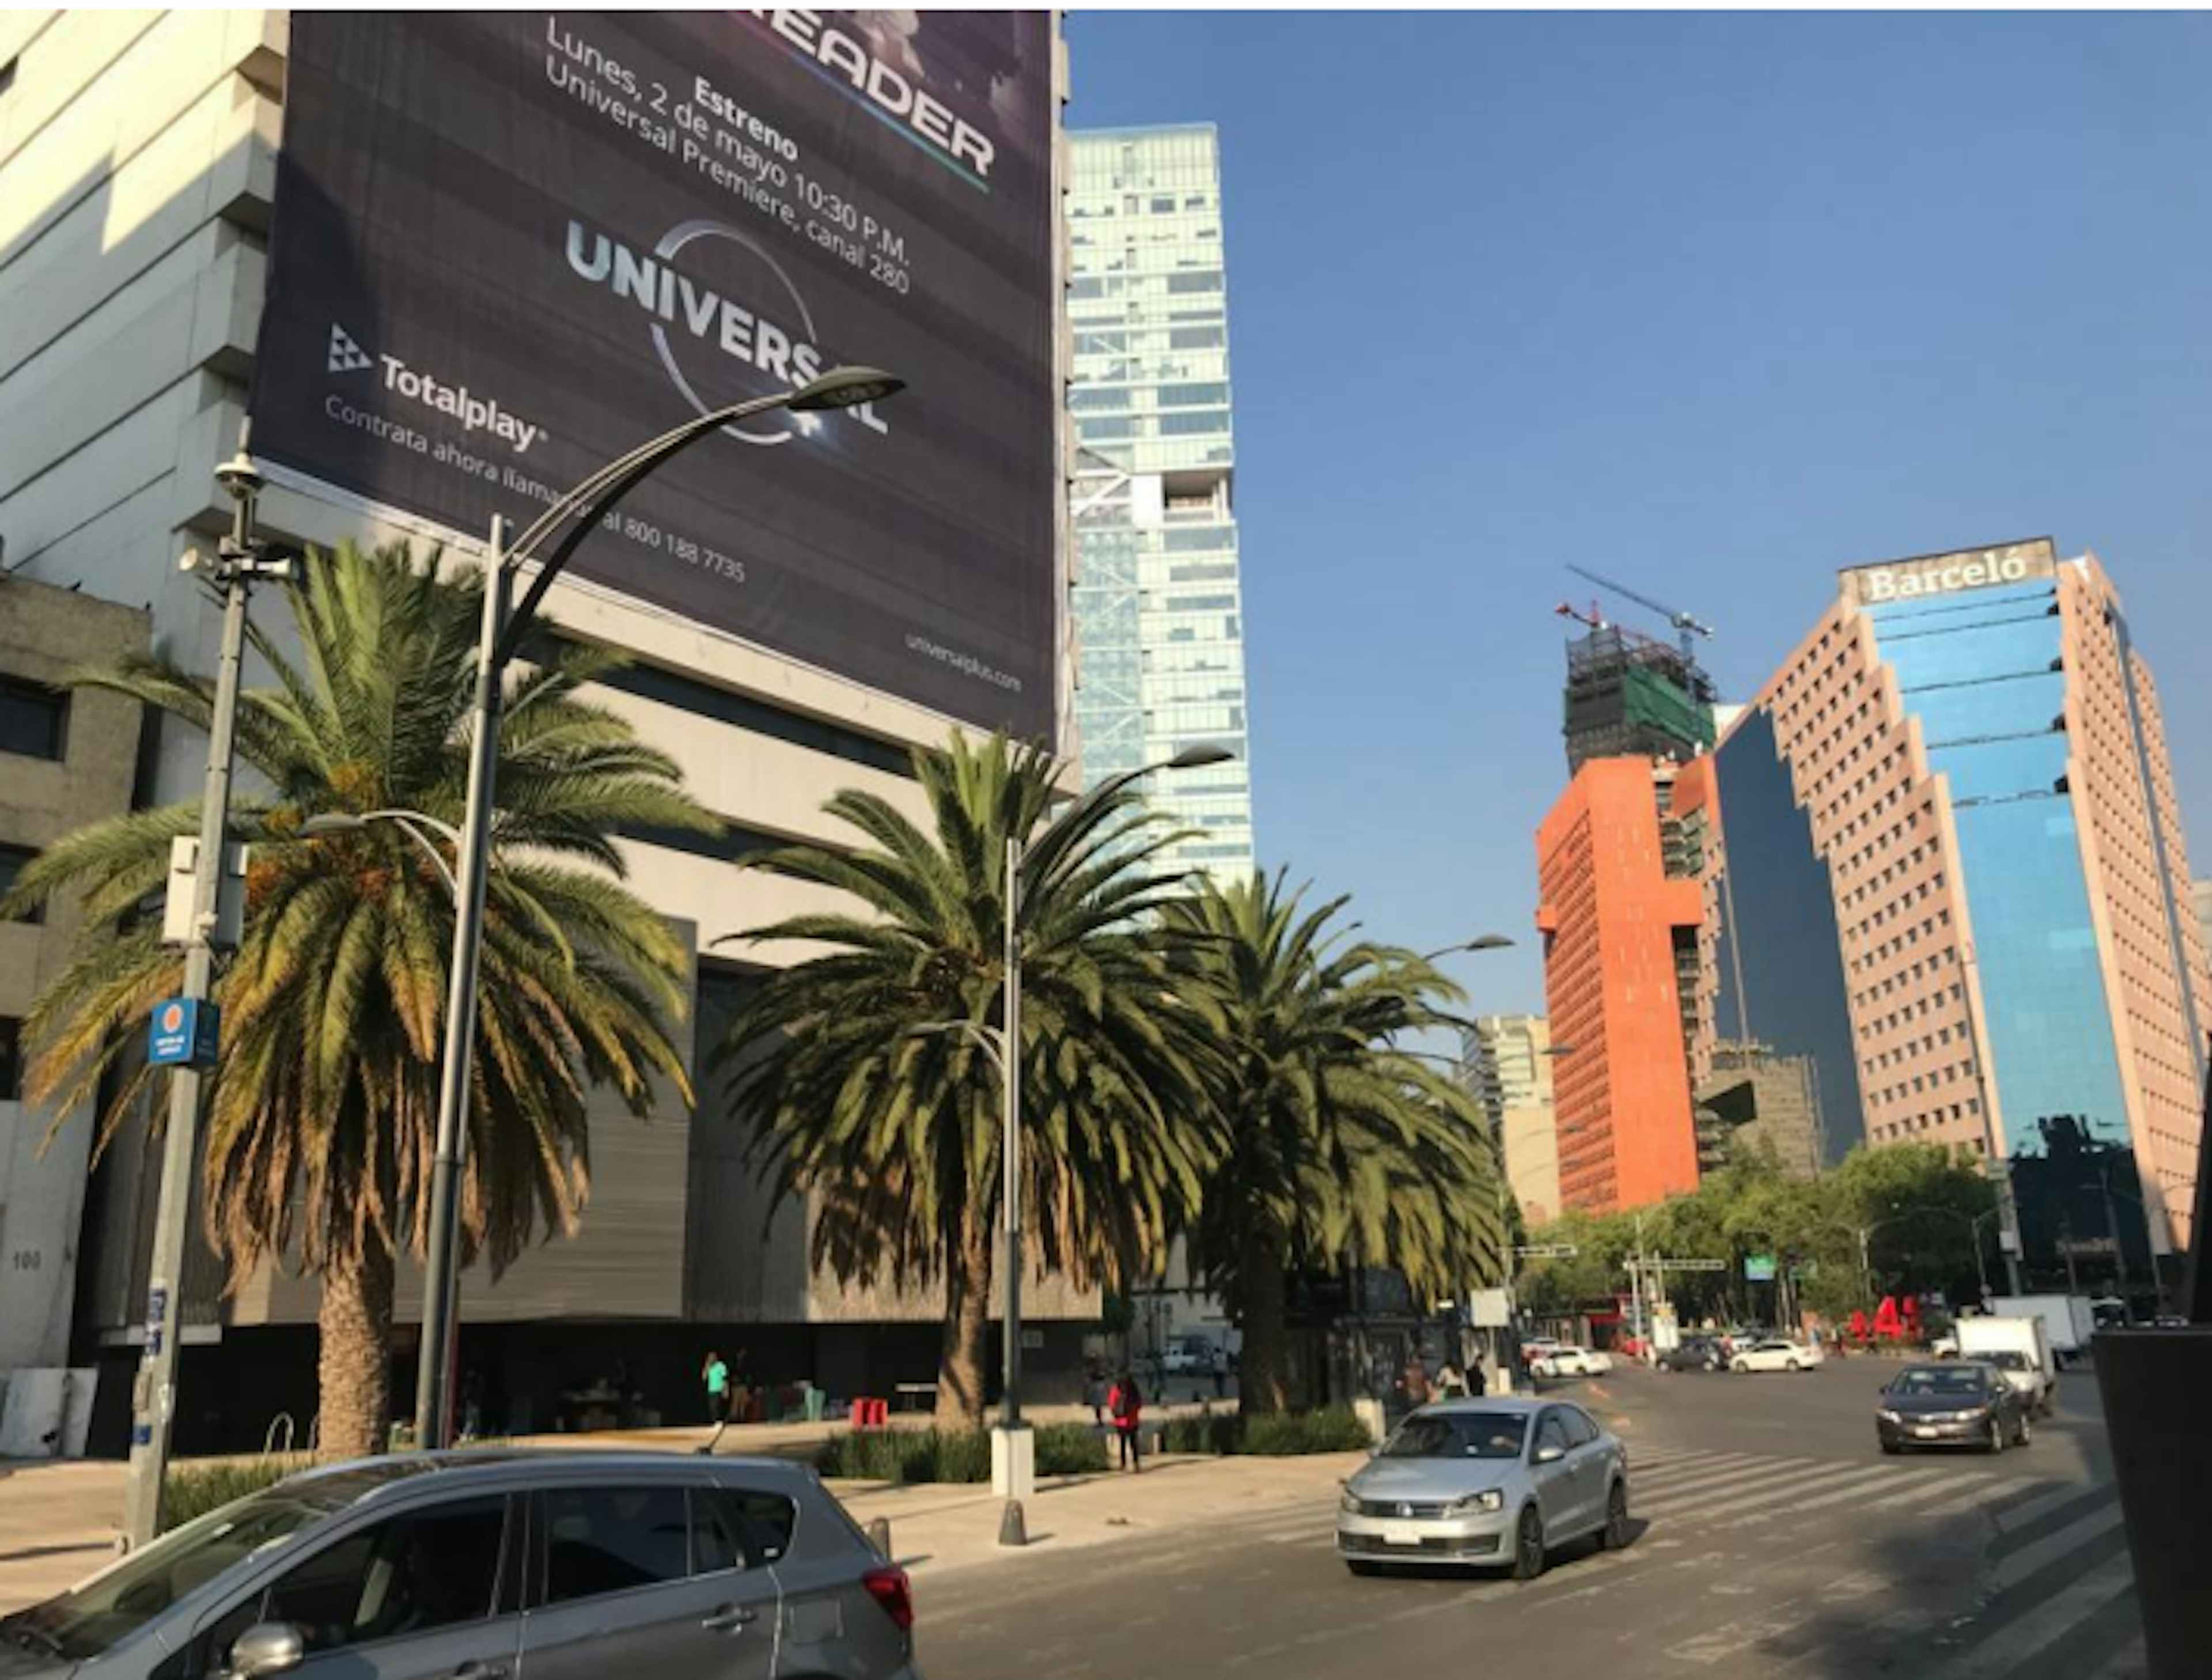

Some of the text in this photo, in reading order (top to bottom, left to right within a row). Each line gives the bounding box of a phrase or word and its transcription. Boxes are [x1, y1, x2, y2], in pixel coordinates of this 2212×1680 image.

[547, 15, 910, 267] Lunes, 2 de mayo 10:30 P.M.
[547, 54, 910, 294] Universal Premiere, canal 280
[695, 75, 798, 161] Estreno
[751, 10, 994, 175] EADER
[567, 220, 889, 434] UNIVERSL
[325, 395, 427, 453] Contrata
[433, 441, 498, 482] ahora
[603, 511, 620, 531] al
[624, 518, 661, 548] 800
[703, 547, 745, 583] 7735
[1868, 547, 2027, 601] Barceló
